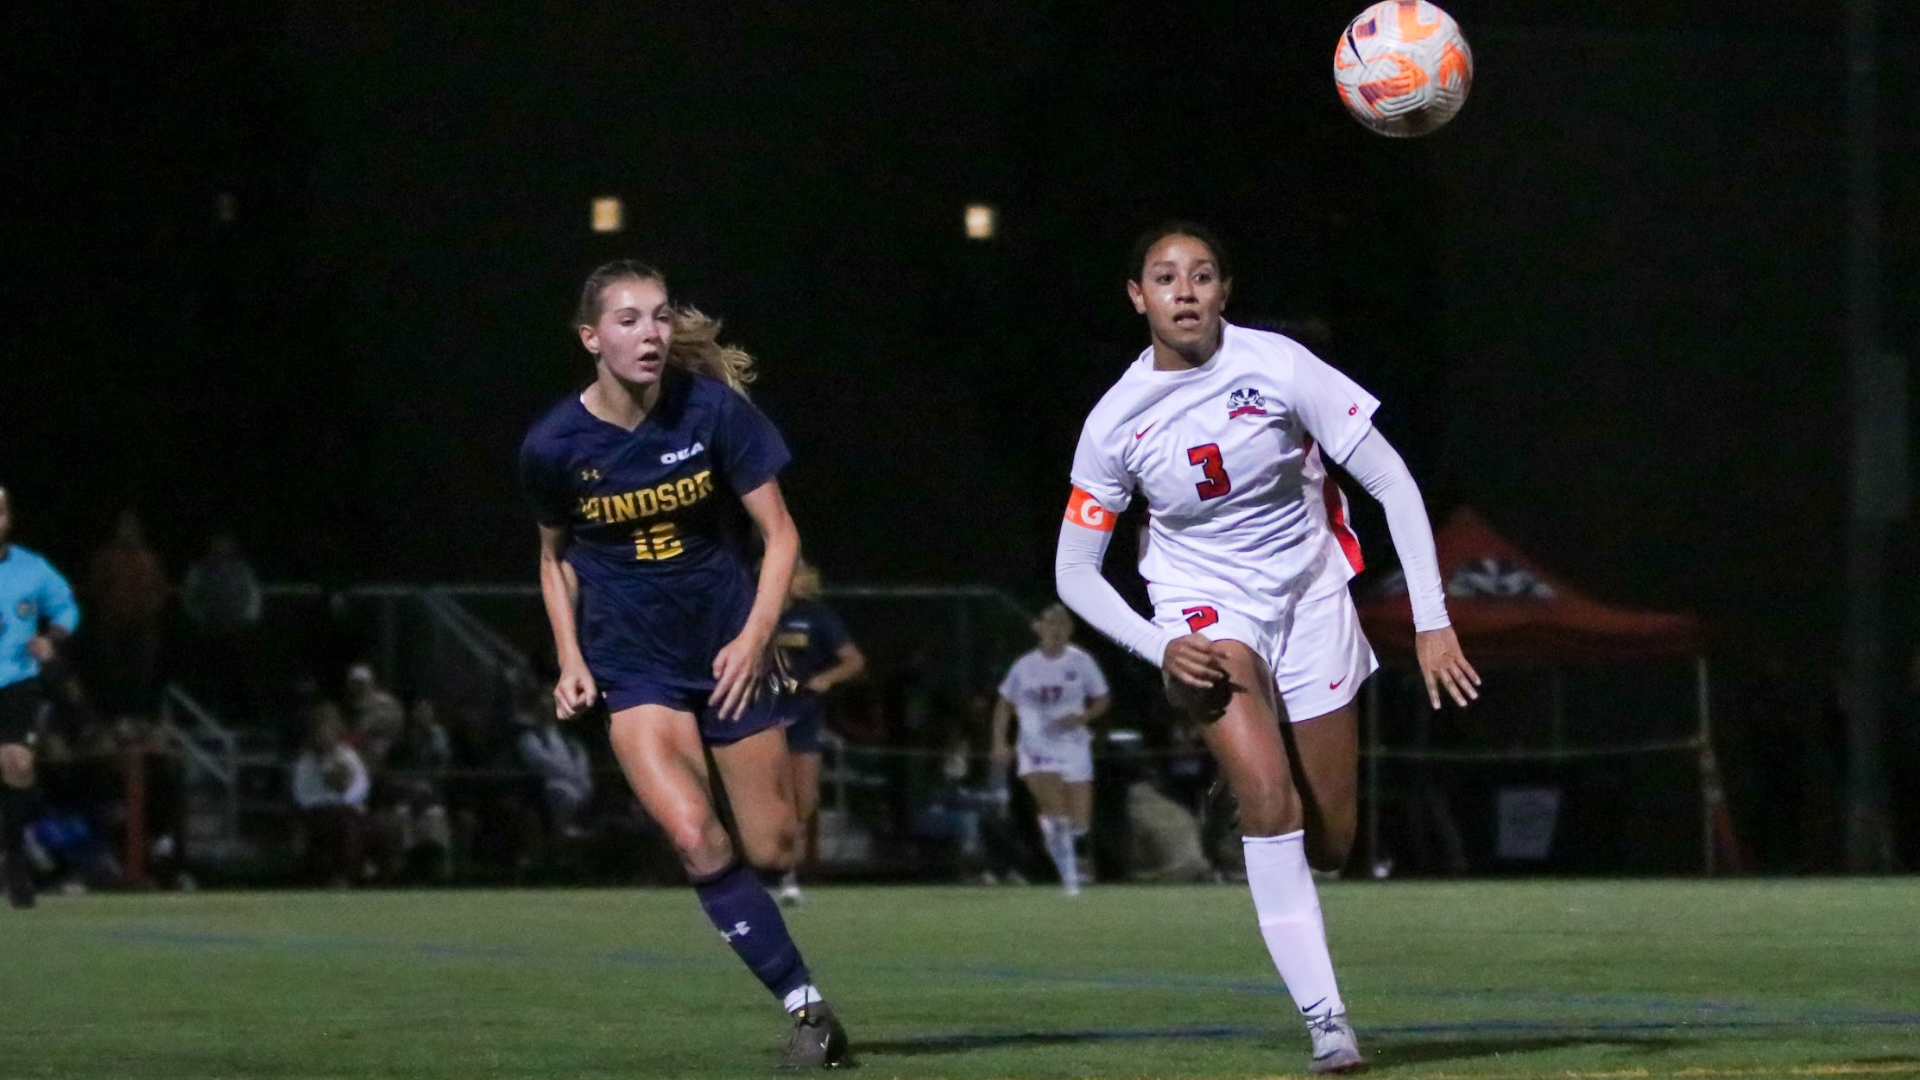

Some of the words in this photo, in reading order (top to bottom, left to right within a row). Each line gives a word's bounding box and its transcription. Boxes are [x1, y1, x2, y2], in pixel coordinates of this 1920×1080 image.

[1187, 443, 1231, 501] 3
[1081, 498, 1104, 526] G
[631, 522, 684, 560] 12
